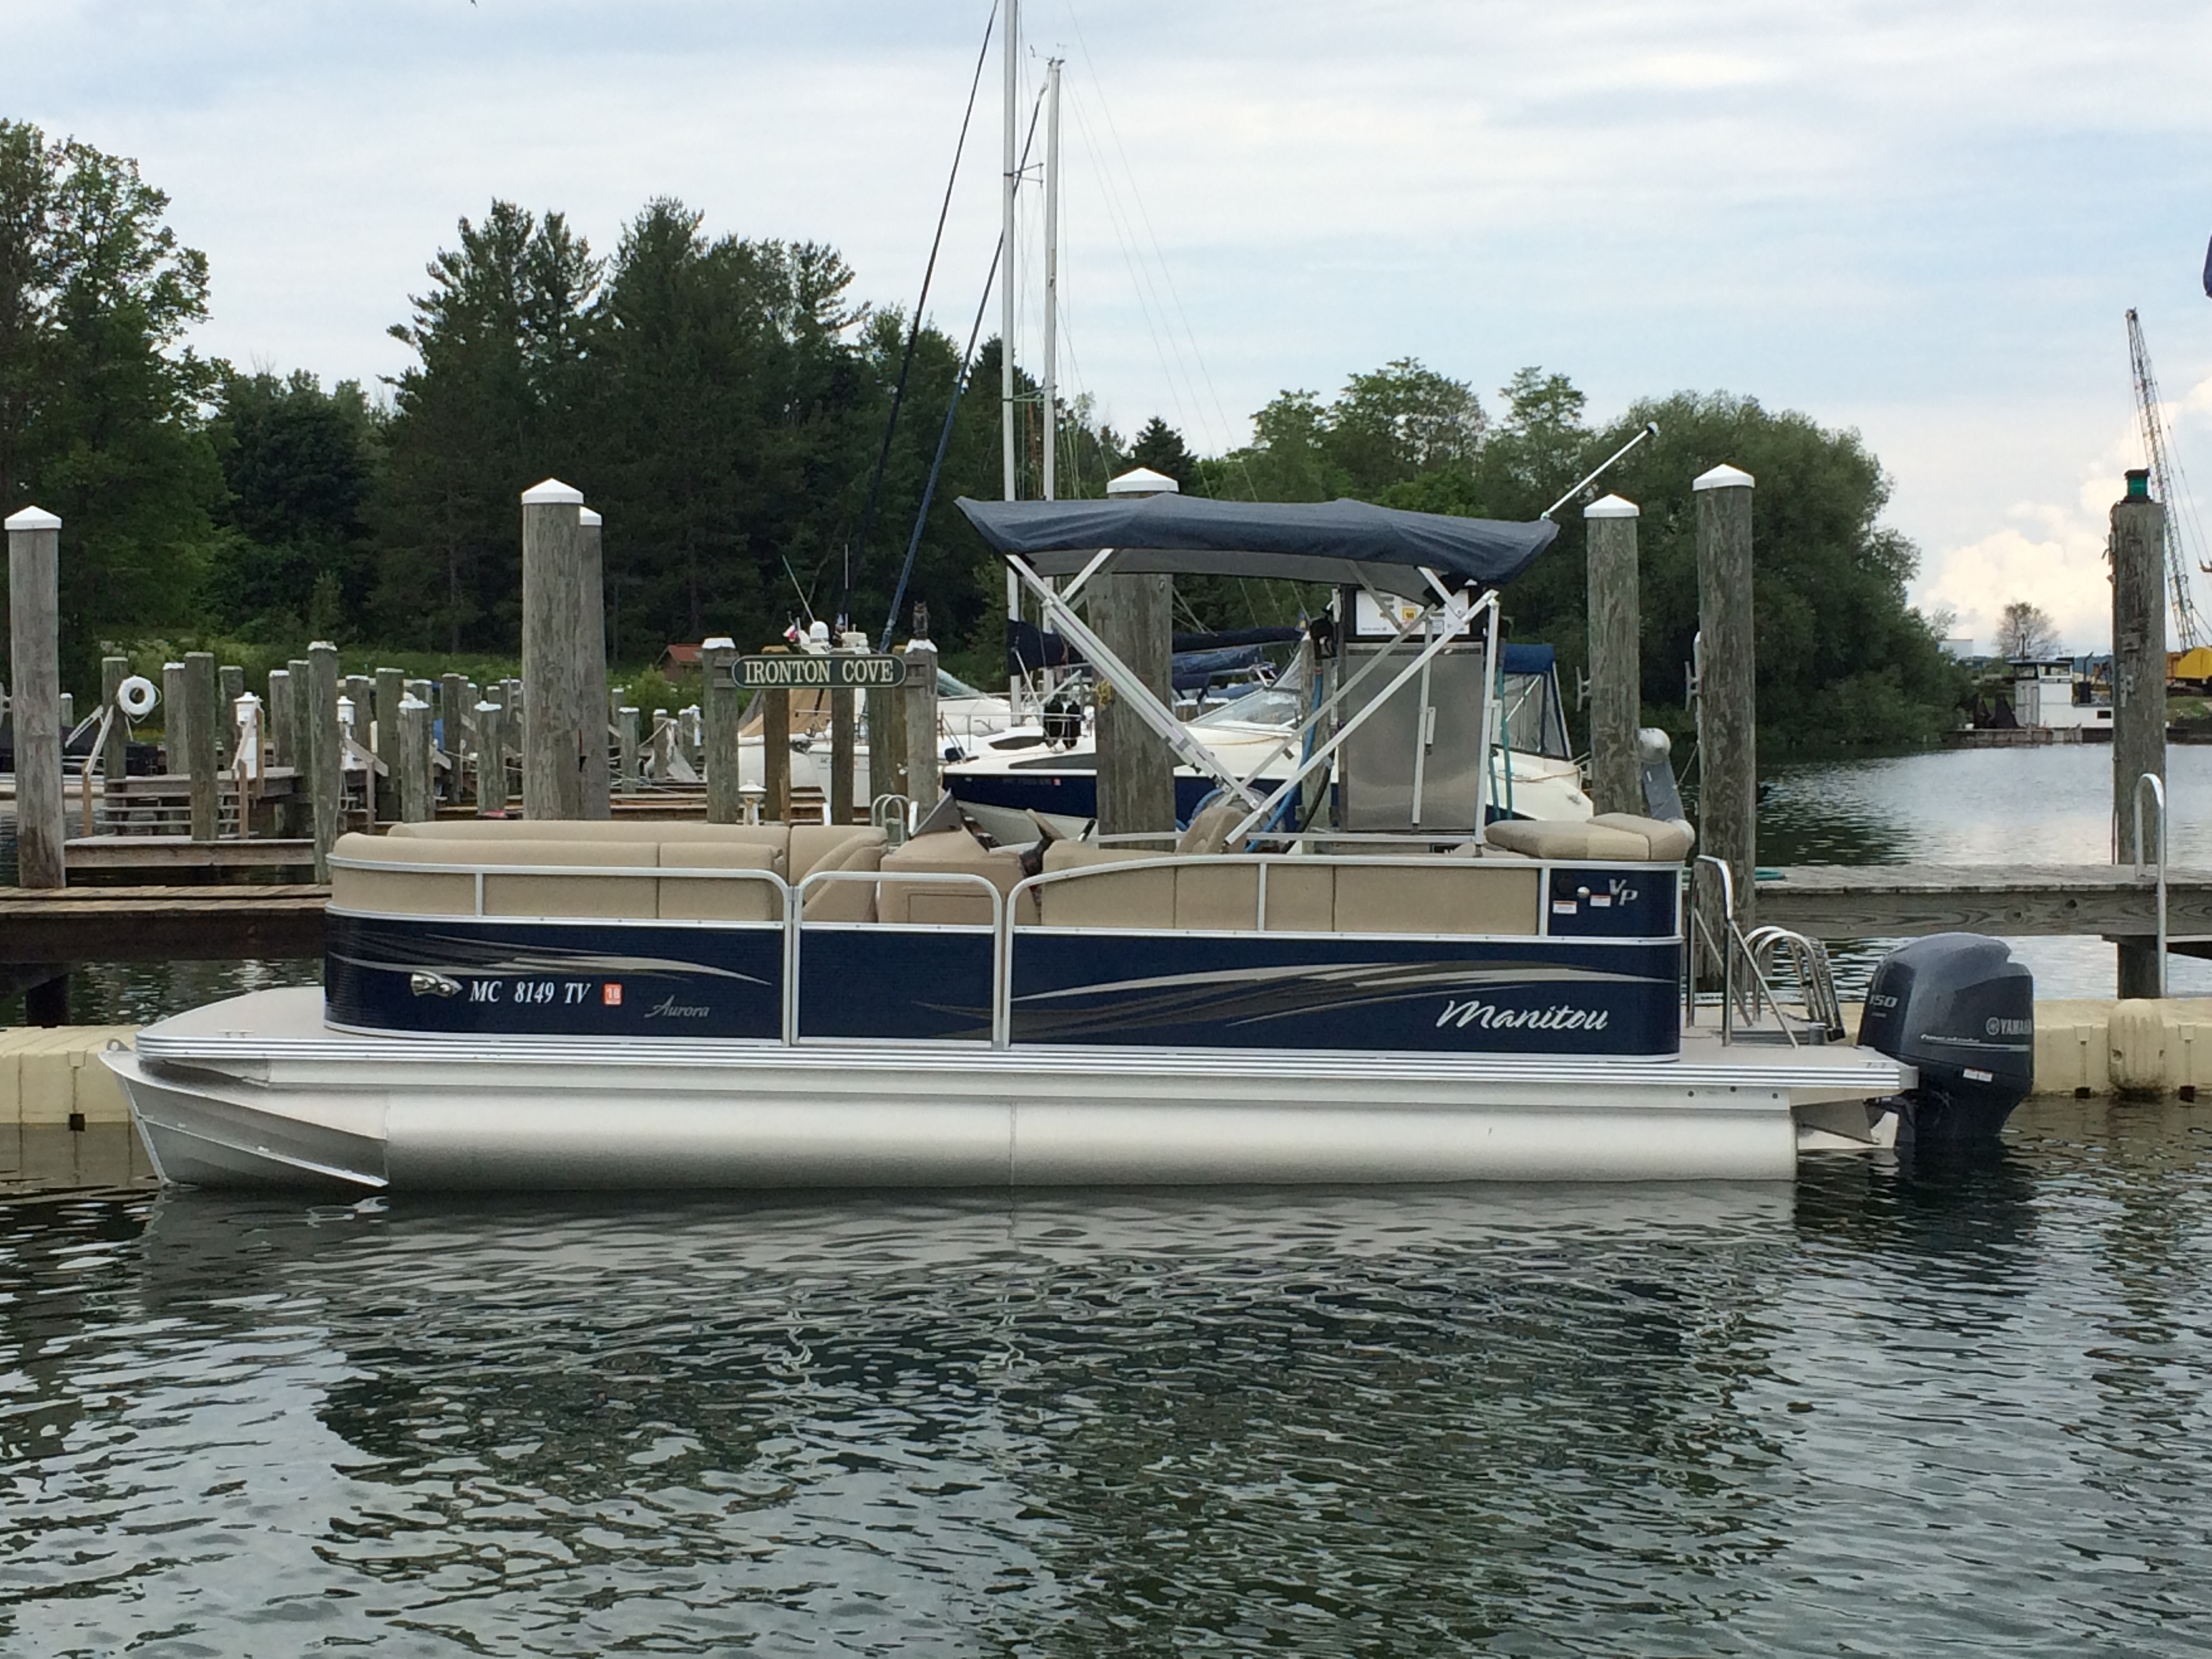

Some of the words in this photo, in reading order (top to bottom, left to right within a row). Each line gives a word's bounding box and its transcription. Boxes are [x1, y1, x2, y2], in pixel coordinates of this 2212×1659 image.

[744, 659, 832, 684] IRONTON
[842, 659, 894, 682] COVE
[469, 980, 503, 1002] MC
[513, 981, 556, 1004] 8149
[564, 982, 592, 1004] TV
[1869, 994, 1899, 1008] 150
[644, 994, 711, 1019] Aurora
[1435, 999, 1609, 1031] Manitou
